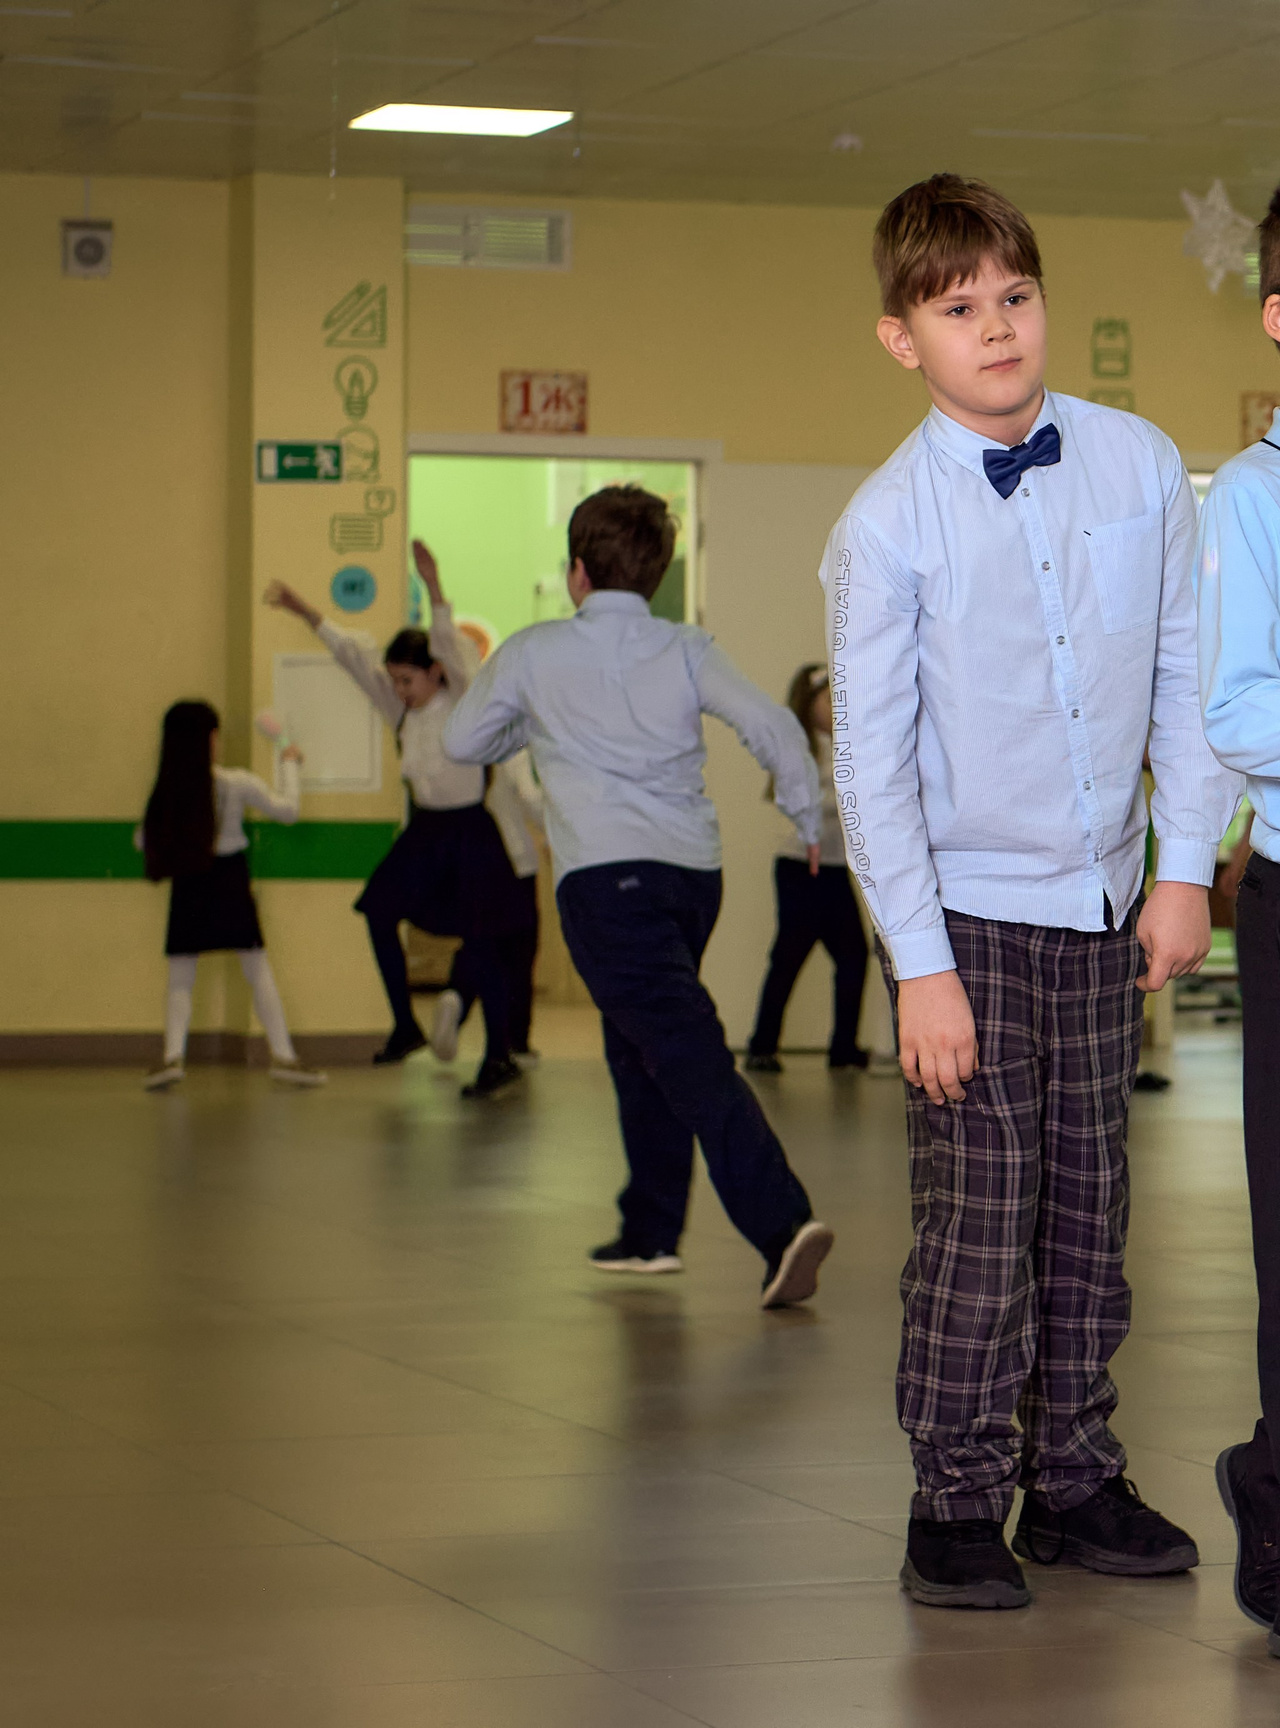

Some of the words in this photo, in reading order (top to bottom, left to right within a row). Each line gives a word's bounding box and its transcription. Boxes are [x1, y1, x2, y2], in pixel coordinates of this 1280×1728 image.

[833, 549, 852, 651] GOALS
[832, 663, 848, 731] NEW
[833, 741, 855, 783] ON
[840, 791, 876, 889] FOCUS
